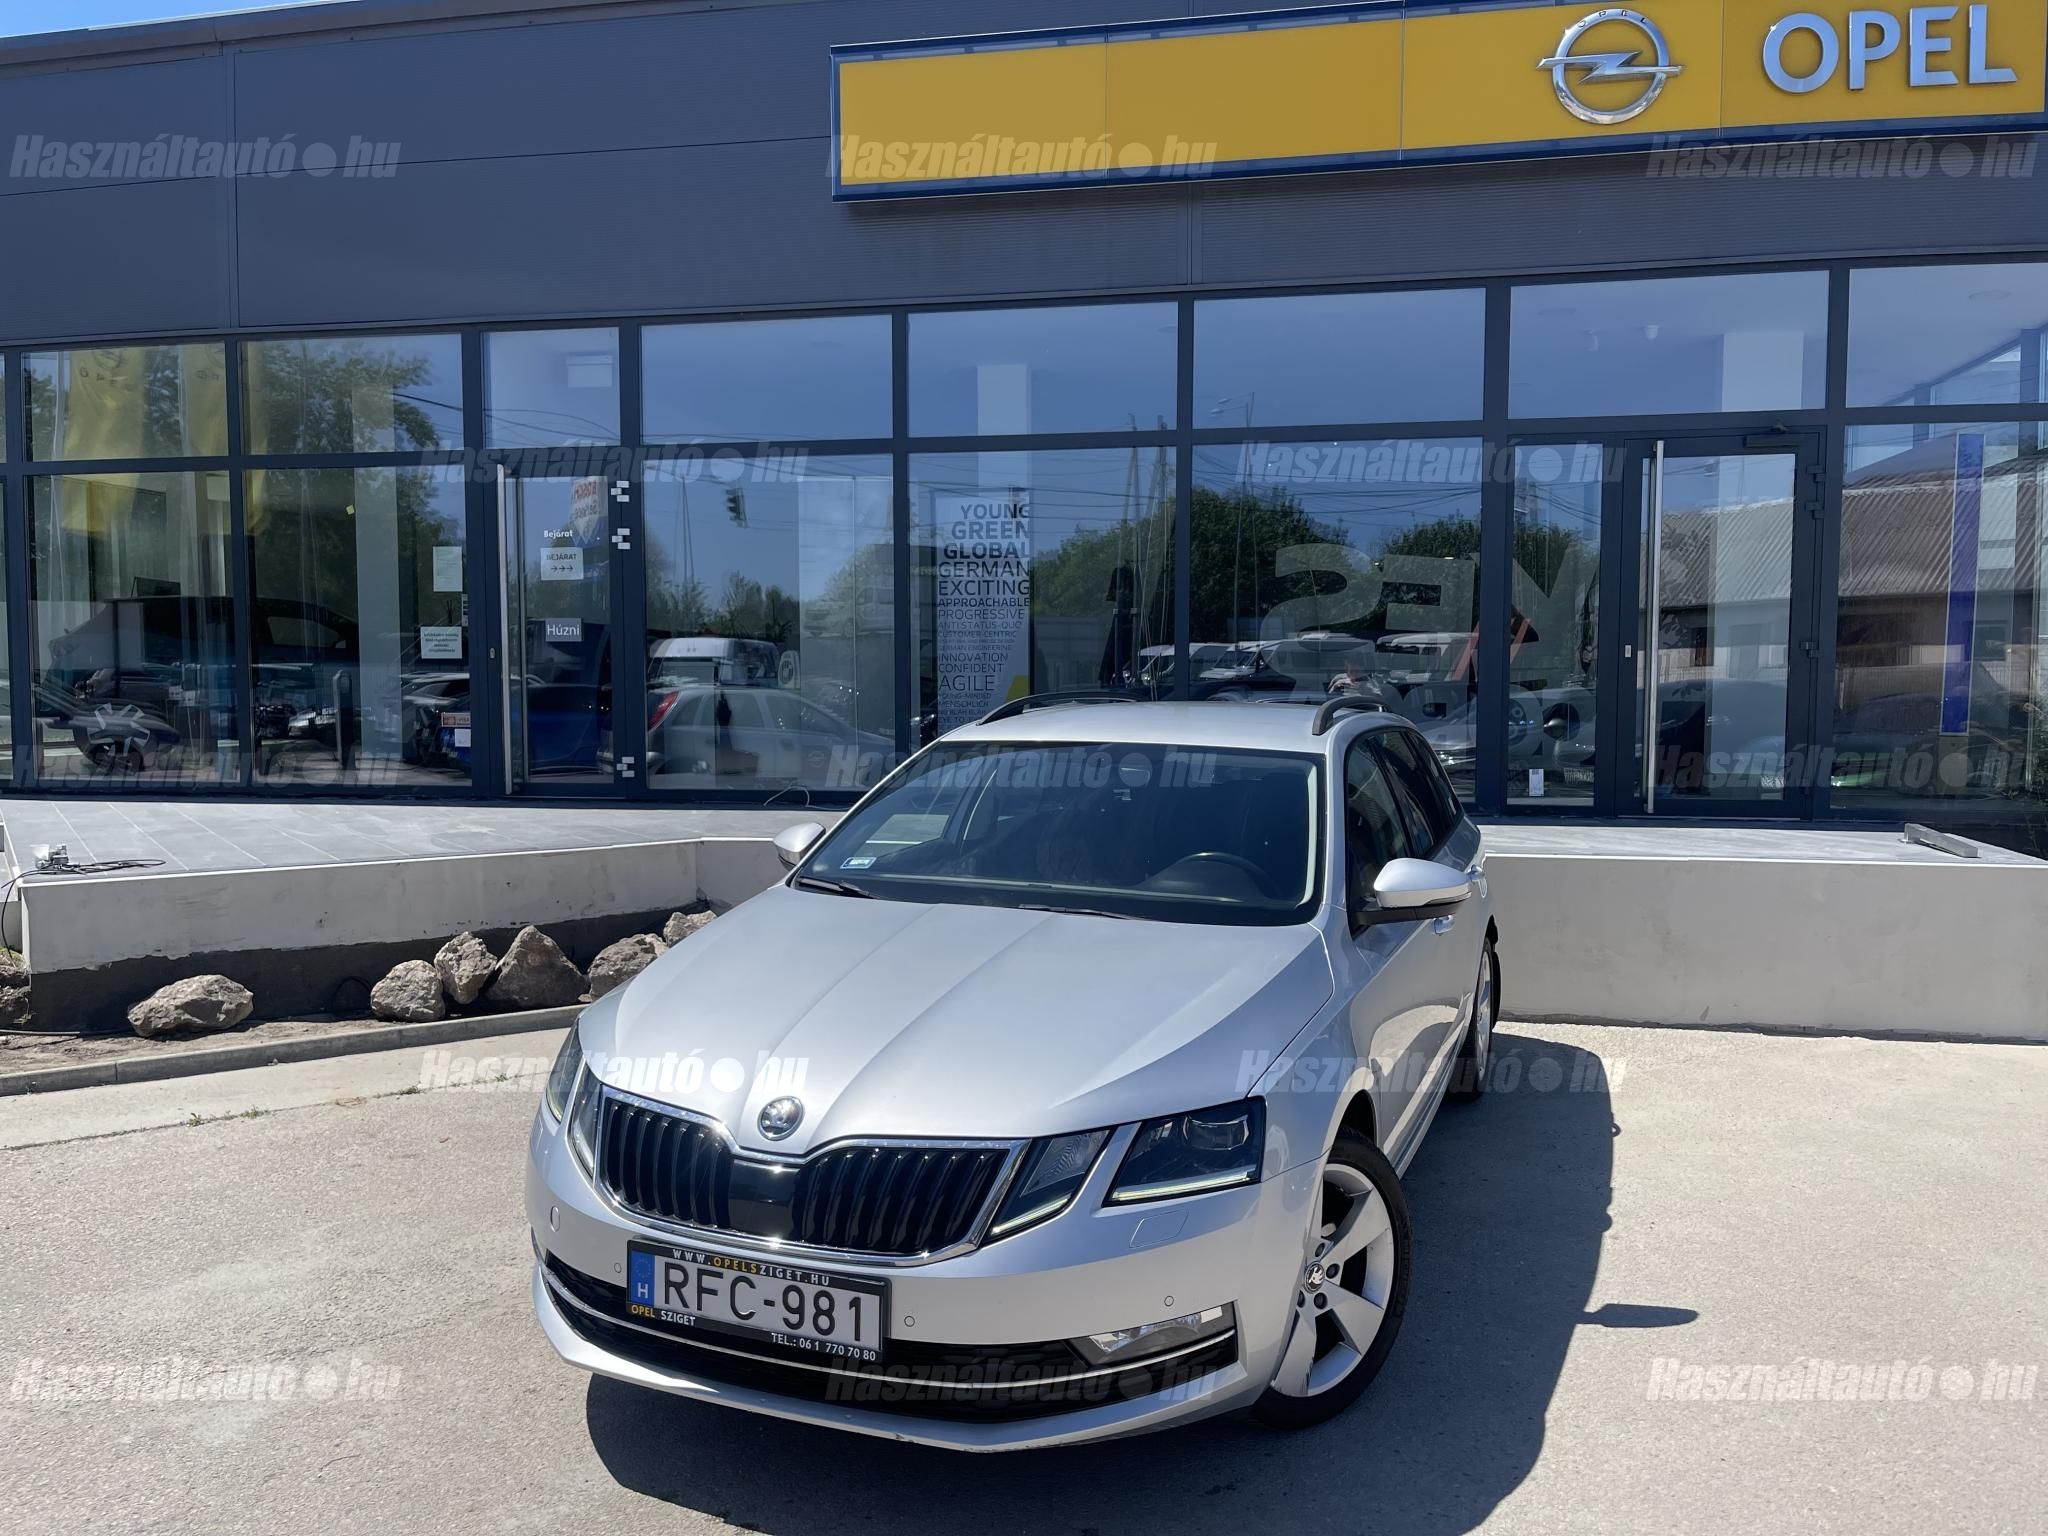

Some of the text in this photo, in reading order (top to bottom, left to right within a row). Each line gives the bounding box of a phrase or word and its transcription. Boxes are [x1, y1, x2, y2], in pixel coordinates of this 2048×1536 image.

[1577, 9, 1646, 28] OPEL
[1762, 4, 2018, 93] OPEL
[960, 503, 1030, 520] YOUNG
[543, 529, 573, 539] Bejárat
[951, 520, 1030, 540] GREEN
[943, 541, 1030, 560] GLOBAL
[938, 561, 1030, 578] GERMAN
[938, 579, 1030, 596] EXCITING
[938, 597, 1030, 607] APPROACHABLE
[938, 609, 1025, 620] PROGRESSIVE
[546, 623, 580, 636] Húzni
[938, 653, 1009, 662] INNOVATION
[938, 663, 1005, 673] CONFIDENT
[939, 675, 996, 691] AGILE
[672, 1249, 830, 1286] WWW.OPELSZIGET.HU
[637, 1282, 649, 1299] H
[664, 1261, 862, 1342] RFC-981
[631, 1304, 696, 1326] OPEL SZIGET
[771, 1332, 797, 1347] TEL.:
[826, 1342, 845, 1355] 770
[847, 1346, 861, 1358] 70
[863, 1349, 876, 1361] 80
